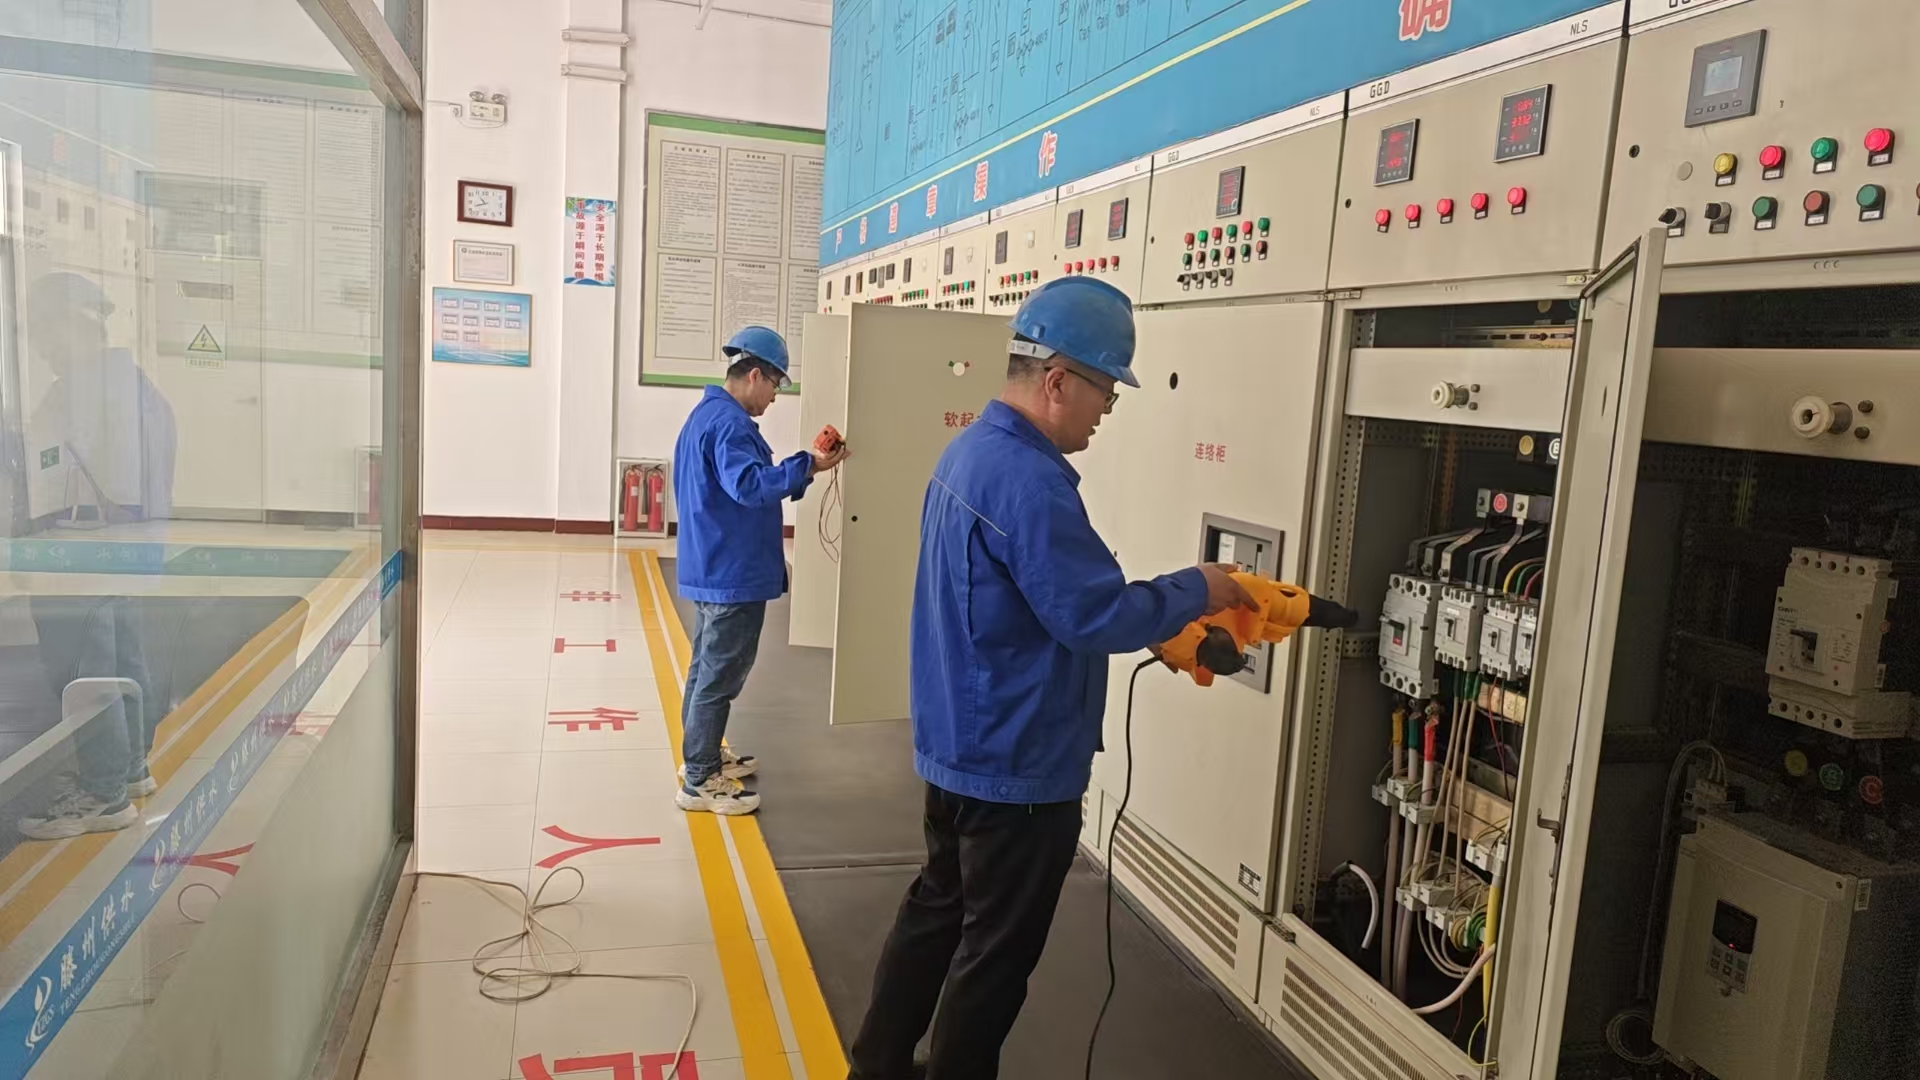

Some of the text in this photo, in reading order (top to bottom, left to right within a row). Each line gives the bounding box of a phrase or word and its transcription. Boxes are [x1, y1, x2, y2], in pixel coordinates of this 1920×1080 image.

[1569, 19, 1588, 36] NLS
[1369, 80, 1390, 99] GGD
[575, 199, 586, 280] 事故源于瞬间麻痹
[595, 203, 605, 281] 安全源于长期警惕
[944, 410, 980, 428] 软起
[1194, 441, 1226, 463] 连络柜
[60, 879, 135, 992] 滕州供水
